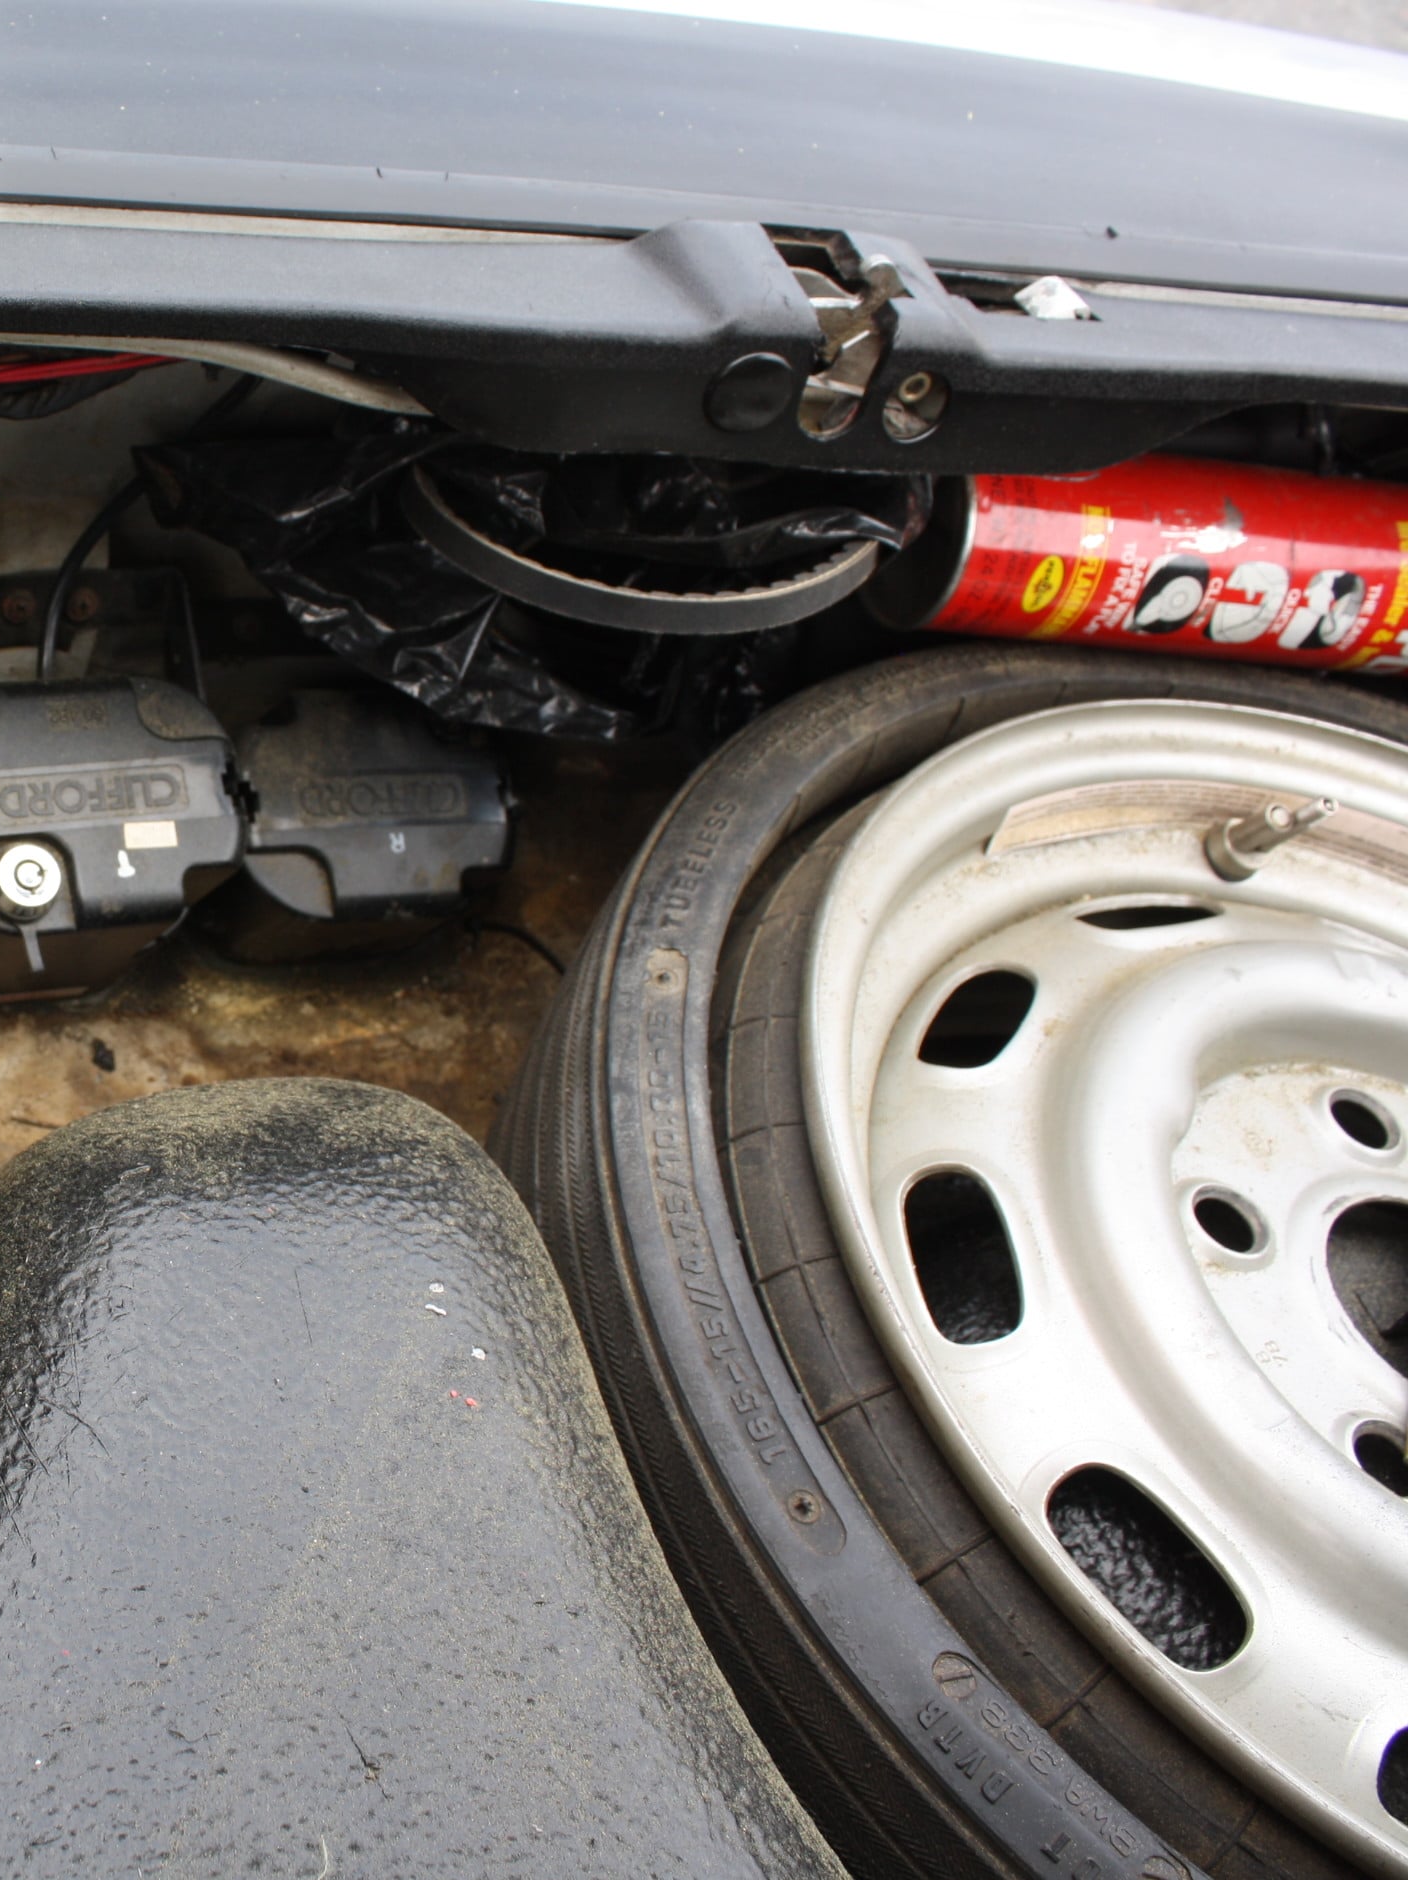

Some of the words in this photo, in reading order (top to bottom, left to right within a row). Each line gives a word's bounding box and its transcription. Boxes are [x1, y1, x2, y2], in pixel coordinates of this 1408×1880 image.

[1120, 543, 1137, 564] TO
[1110, 567, 1130, 590] FIX
[1123, 558, 1147, 599] SAFE
[1103, 593, 1119, 605] A
[1268, 588, 1301, 633] QUICK
[299, 782, 456, 815] CLIFFORD
[657, 798, 737, 925] TUBELESS
[911, 1694, 1016, 1806] DVTB
